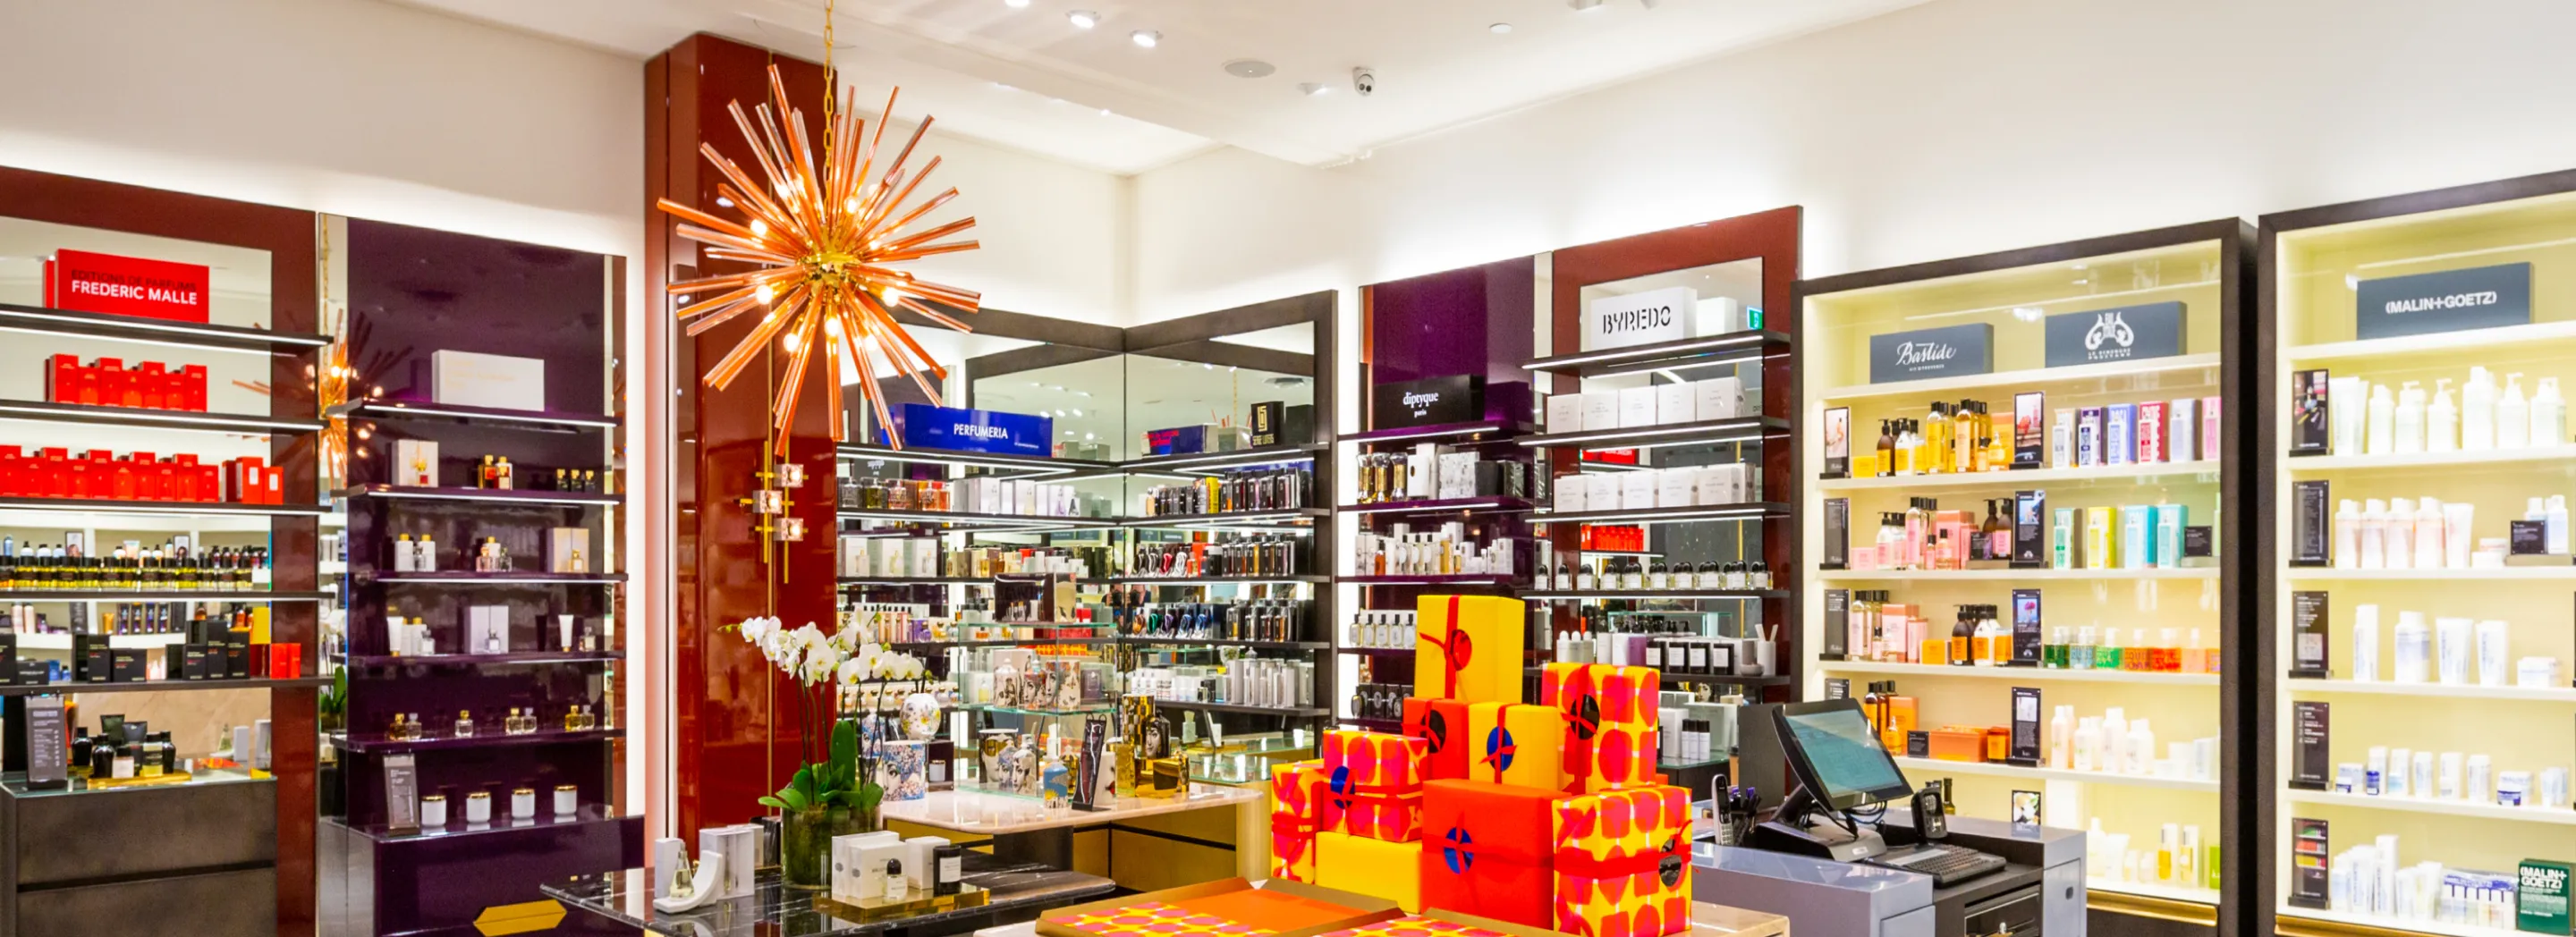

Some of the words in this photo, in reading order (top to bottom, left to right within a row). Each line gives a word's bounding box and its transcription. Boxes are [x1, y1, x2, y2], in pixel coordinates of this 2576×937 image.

[72, 269, 125, 284] EDITIONS
[128, 276, 142, 286] DE
[146, 278, 196, 292] PARFUMS
[72, 280, 144, 300] FREDERIC
[148, 289, 198, 305] MALLE
[2385, 291, 2497, 314] (MALIN+GOETZ)
[1603, 305, 1671, 334] BYREDO
[1895, 341, 1957, 366] Bastide
[1402, 392, 1439, 409] diptyque
[953, 423, 1008, 439] PERFUMERIA
[2520, 866, 2567, 881] (MALIN+
[2521, 875, 2563, 890] GOETZ)
